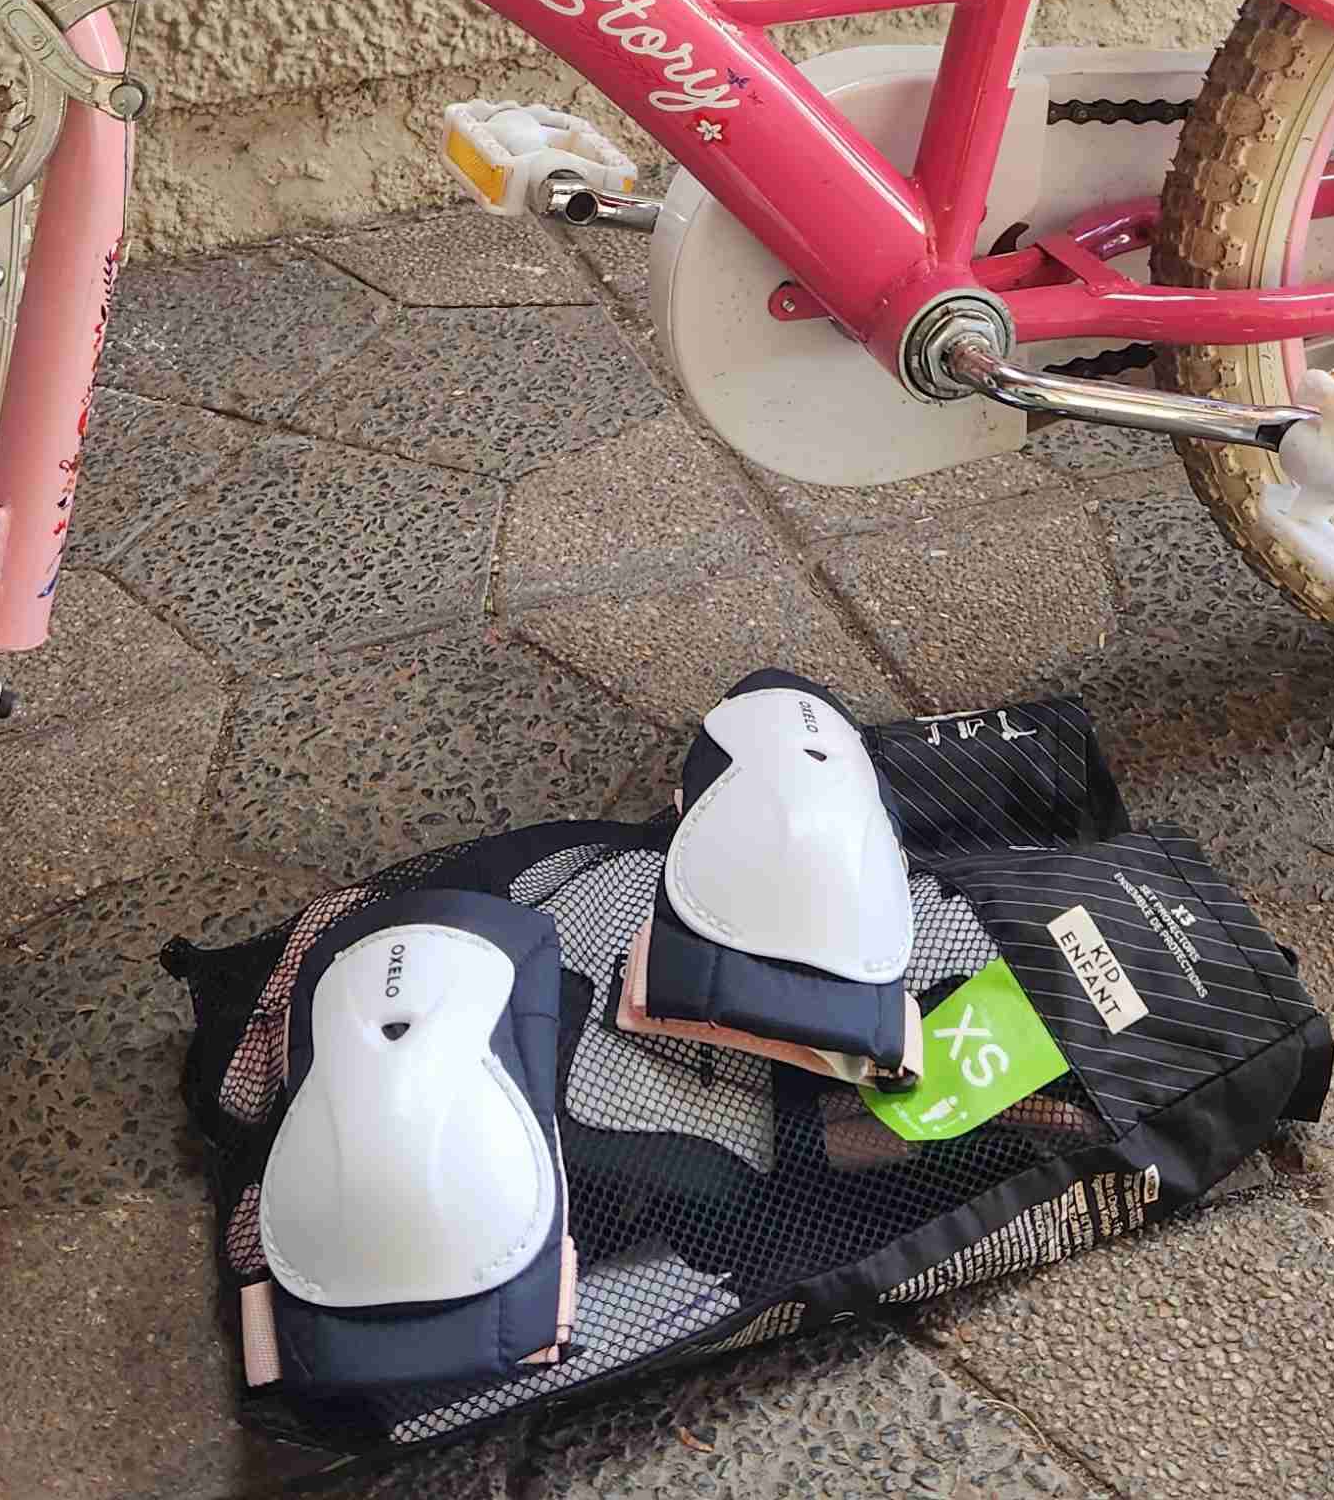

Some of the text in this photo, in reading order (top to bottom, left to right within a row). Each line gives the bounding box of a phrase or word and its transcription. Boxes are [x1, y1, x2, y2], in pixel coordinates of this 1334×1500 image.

[385, 943, 406, 999] OXELO
[1060, 930, 1122, 1016] ENFANT
[1090, 943, 1121, 983] KID
[1158, 928, 1209, 999] PROTECTIONS
[931, 1002, 1011, 1088] XS
